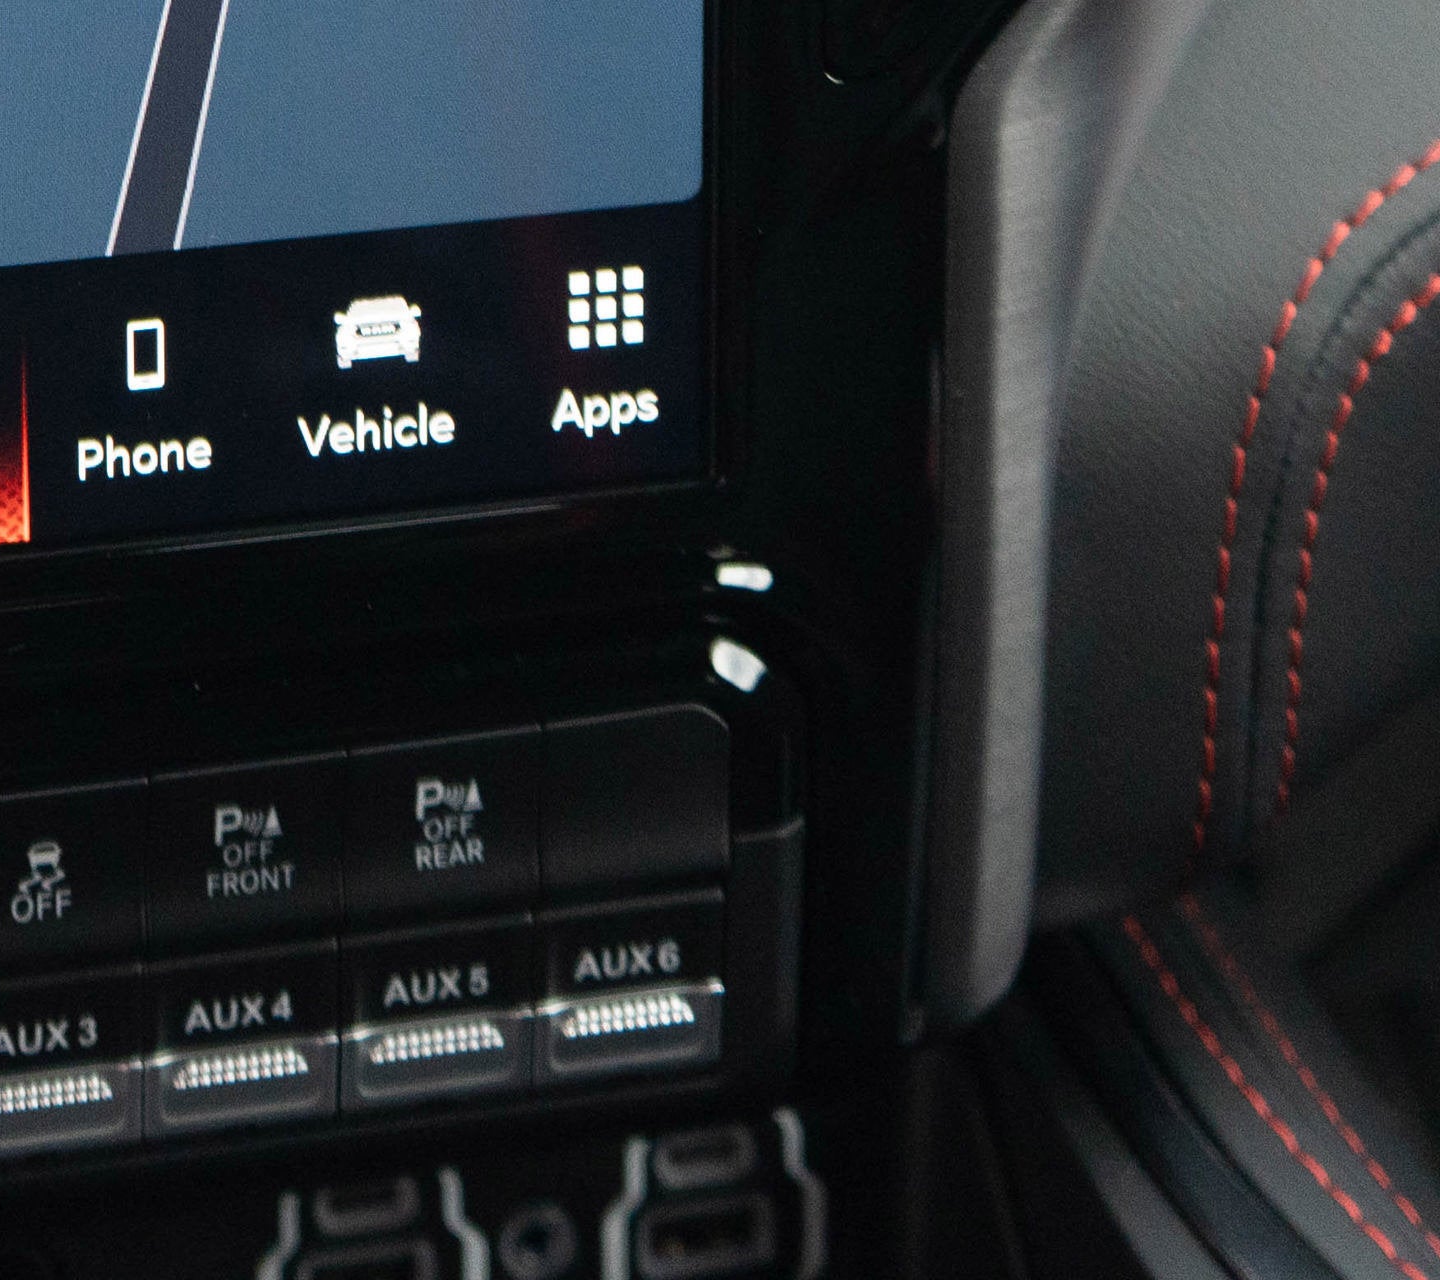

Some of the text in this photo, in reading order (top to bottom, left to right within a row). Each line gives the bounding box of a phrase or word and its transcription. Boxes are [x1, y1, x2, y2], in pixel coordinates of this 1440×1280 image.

[297, 401, 456, 459] Vehicle
[551, 385, 660, 439] Apps
[77, 433, 212, 482] Phone
[423, 815, 474, 842] OFF
[223, 841, 273, 868] OFF
[415, 839, 485, 871] REAR
[206, 864, 295, 898] FRONT
[10, 886, 74, 925] OFF
[574, 940, 680, 985] AUX 6
[382, 966, 489, 1010] AUX 5
[77, 1016, 99, 1050] 3
[184, 992, 292, 1035] AUX 4
